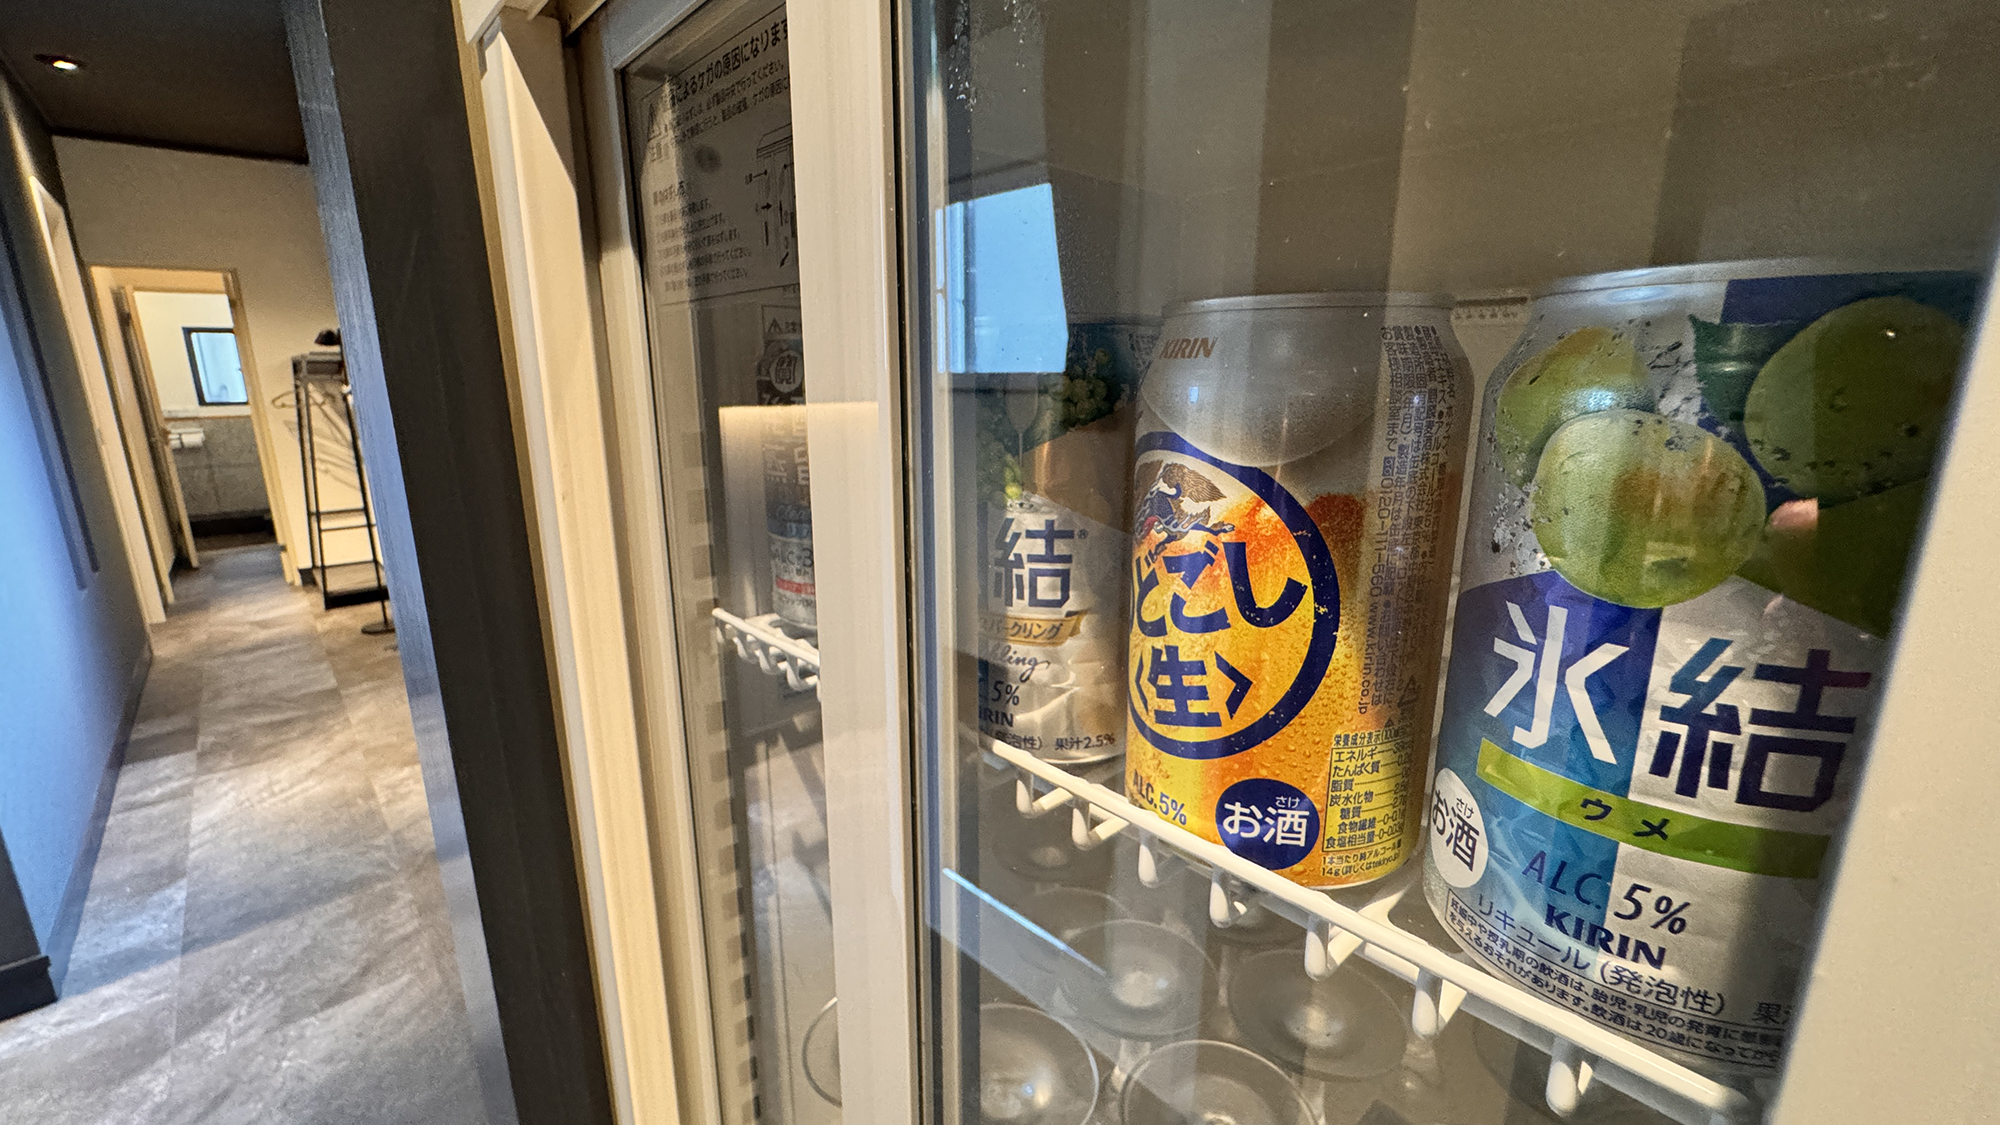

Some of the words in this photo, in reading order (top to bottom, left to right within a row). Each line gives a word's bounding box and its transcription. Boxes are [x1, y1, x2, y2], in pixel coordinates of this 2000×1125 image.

[1160, 337, 1217, 359] KIRIN
[1367, 477, 1395, 596] 0120-111-560
[994, 517, 1074, 608] 結
[1357, 602, 1381, 714] www.kirin.co.jp
[1055, 733, 1116, 750] 果汁2.5%
[1332, 760, 1381, 777] たんぱく質
[1331, 778, 1354, 792] 脂質
[1275, 796, 1301, 809] さけ
[1329, 790, 1374, 806] 炭水化物
[1455, 798, 1475, 819] さけ
[1340, 806, 1362, 820] 糖質
[1580, 798, 1670, 841] ウメ
[1222, 801, 1310, 847] お酒
[1338, 817, 1376, 835] 食物繊維
[1430, 789, 1478, 873] お酒
[1325, 831, 1375, 849] 食塩相当量
[1543, 903, 1667, 971] KIRIN
